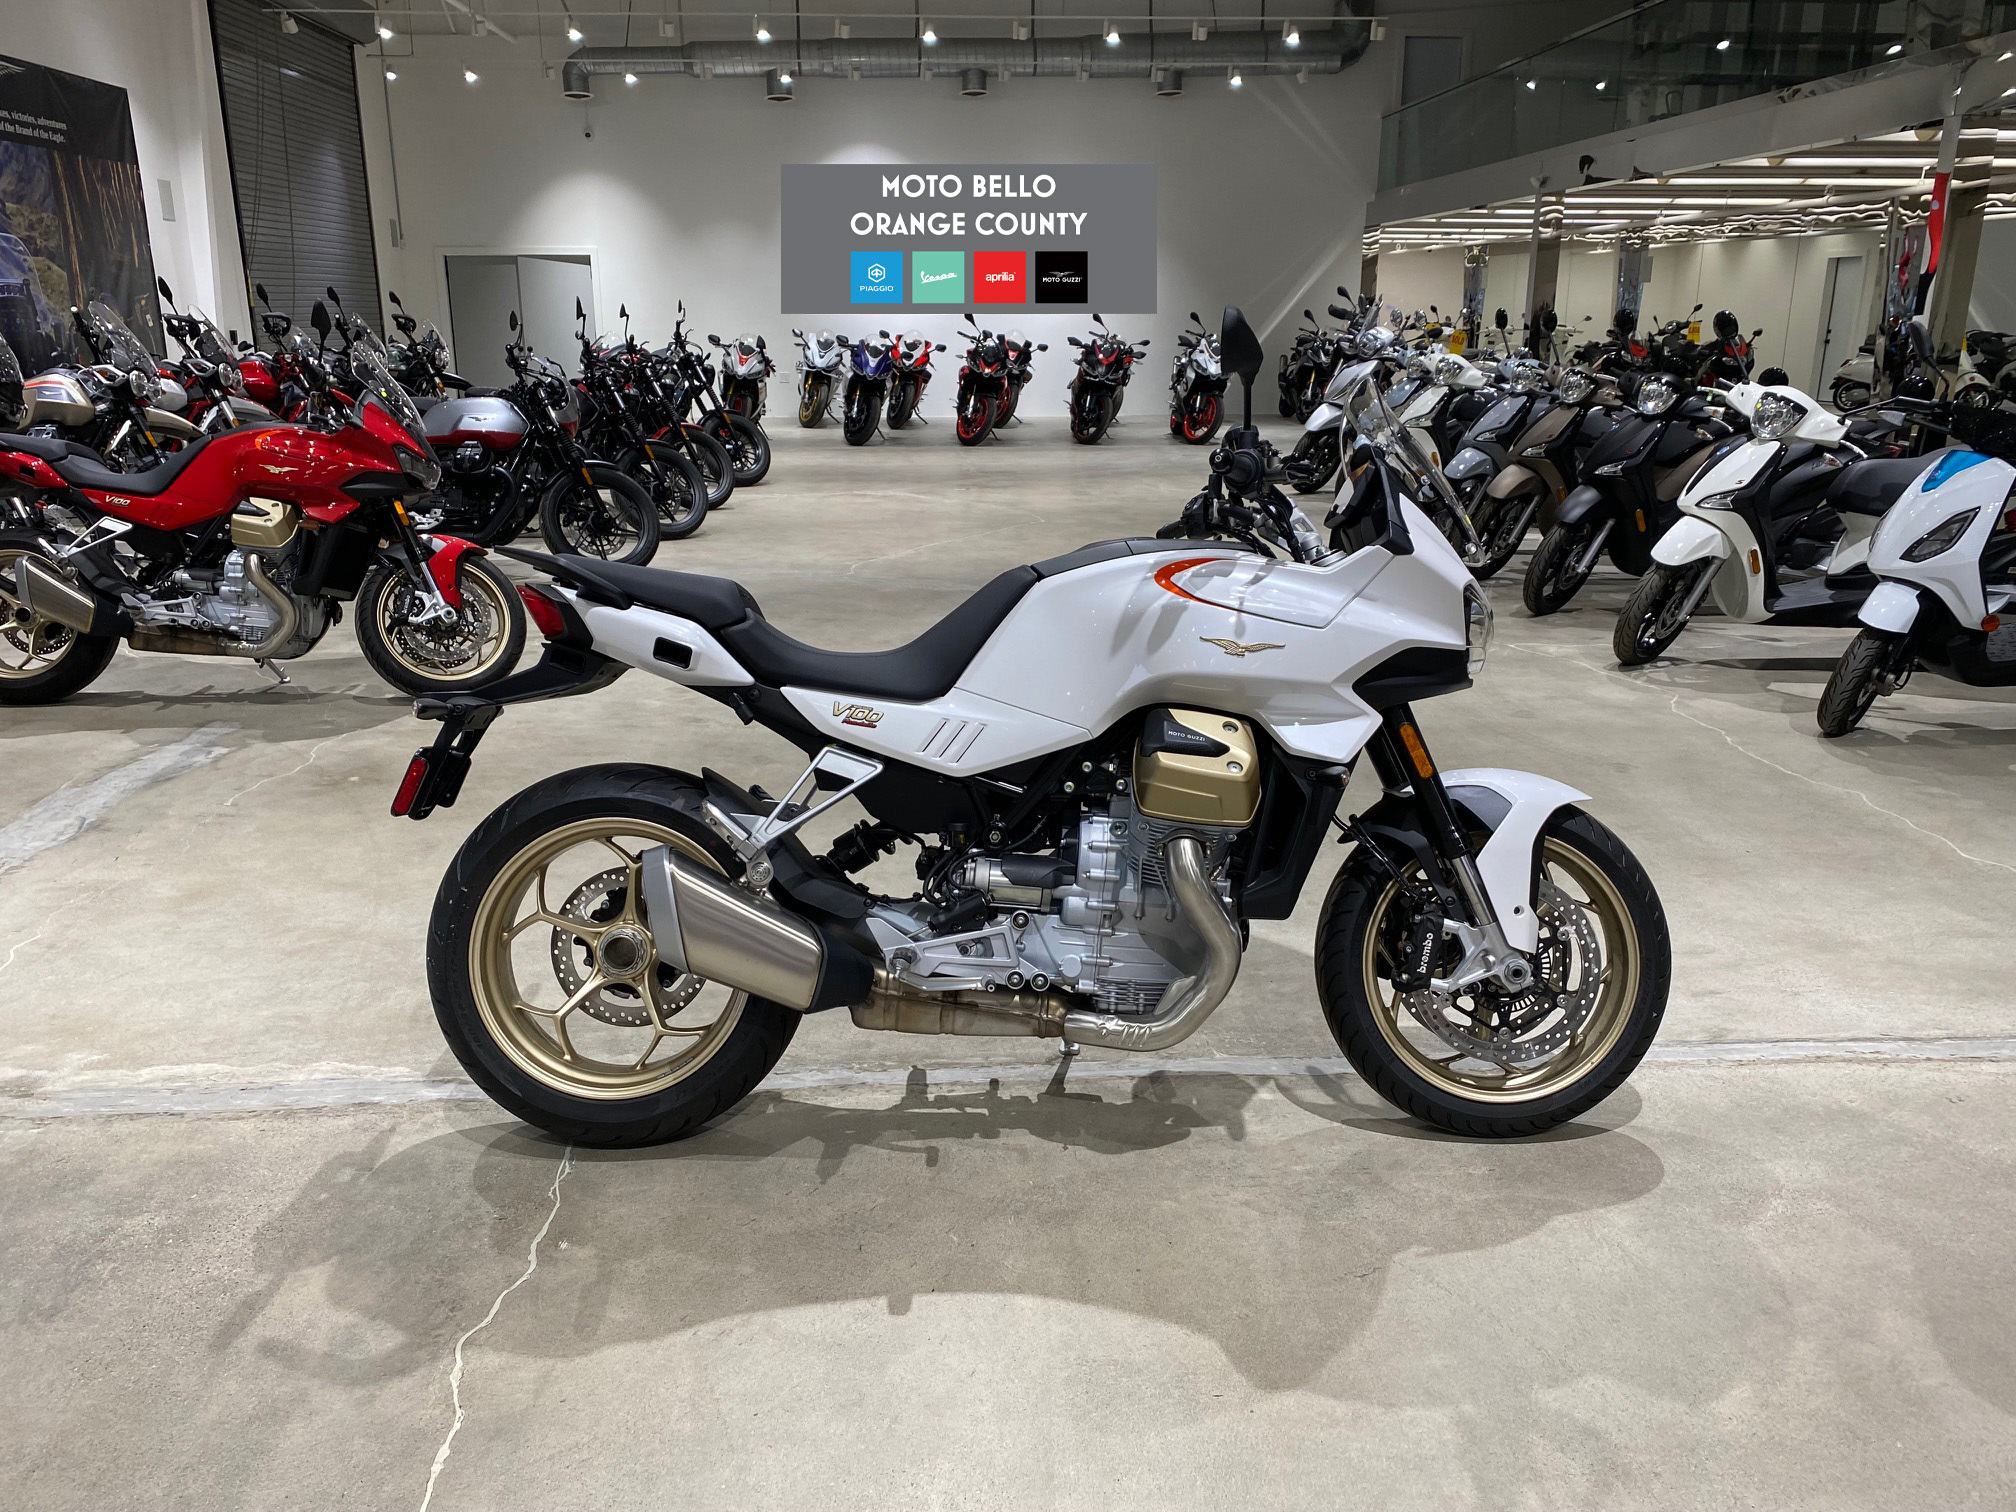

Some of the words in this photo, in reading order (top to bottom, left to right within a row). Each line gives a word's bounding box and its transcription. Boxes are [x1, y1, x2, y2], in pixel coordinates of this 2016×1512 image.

[11, 110, 37, 125] victories,
[37, 116, 67, 130] adventures
[5, 122, 15, 132] the
[15, 124, 33, 136] Brand
[33, 128, 39, 137] of
[40, 129, 49, 139] the
[1451, 335, 1465, 345] SOLD
[105, 494, 131, 506] V100
[833, 701, 884, 722] V100
[1416, 932, 1434, 974] brembo
